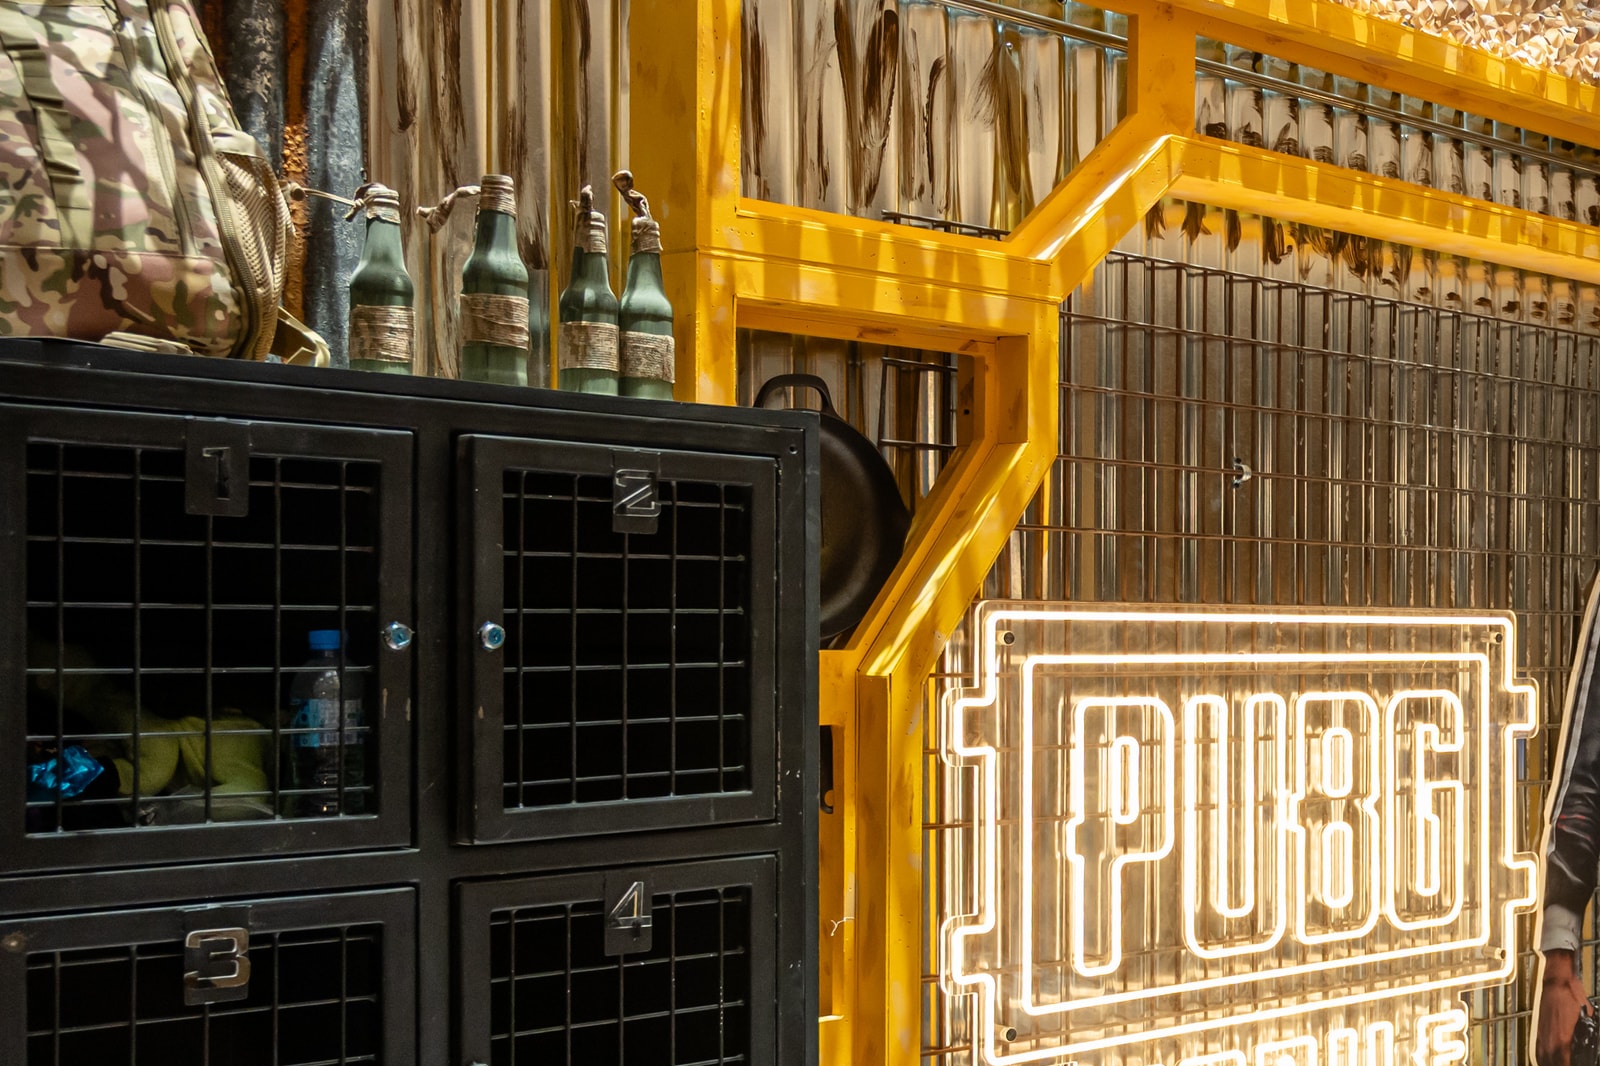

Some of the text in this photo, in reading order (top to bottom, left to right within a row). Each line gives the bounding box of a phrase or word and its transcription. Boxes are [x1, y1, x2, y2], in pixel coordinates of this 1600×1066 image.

[202, 446, 232, 501] 1
[613, 468, 661, 517] 2
[1065, 688, 1465, 979] PUBG
[607, 881, 653, 942] 4
[183, 926, 251, 990] 3
